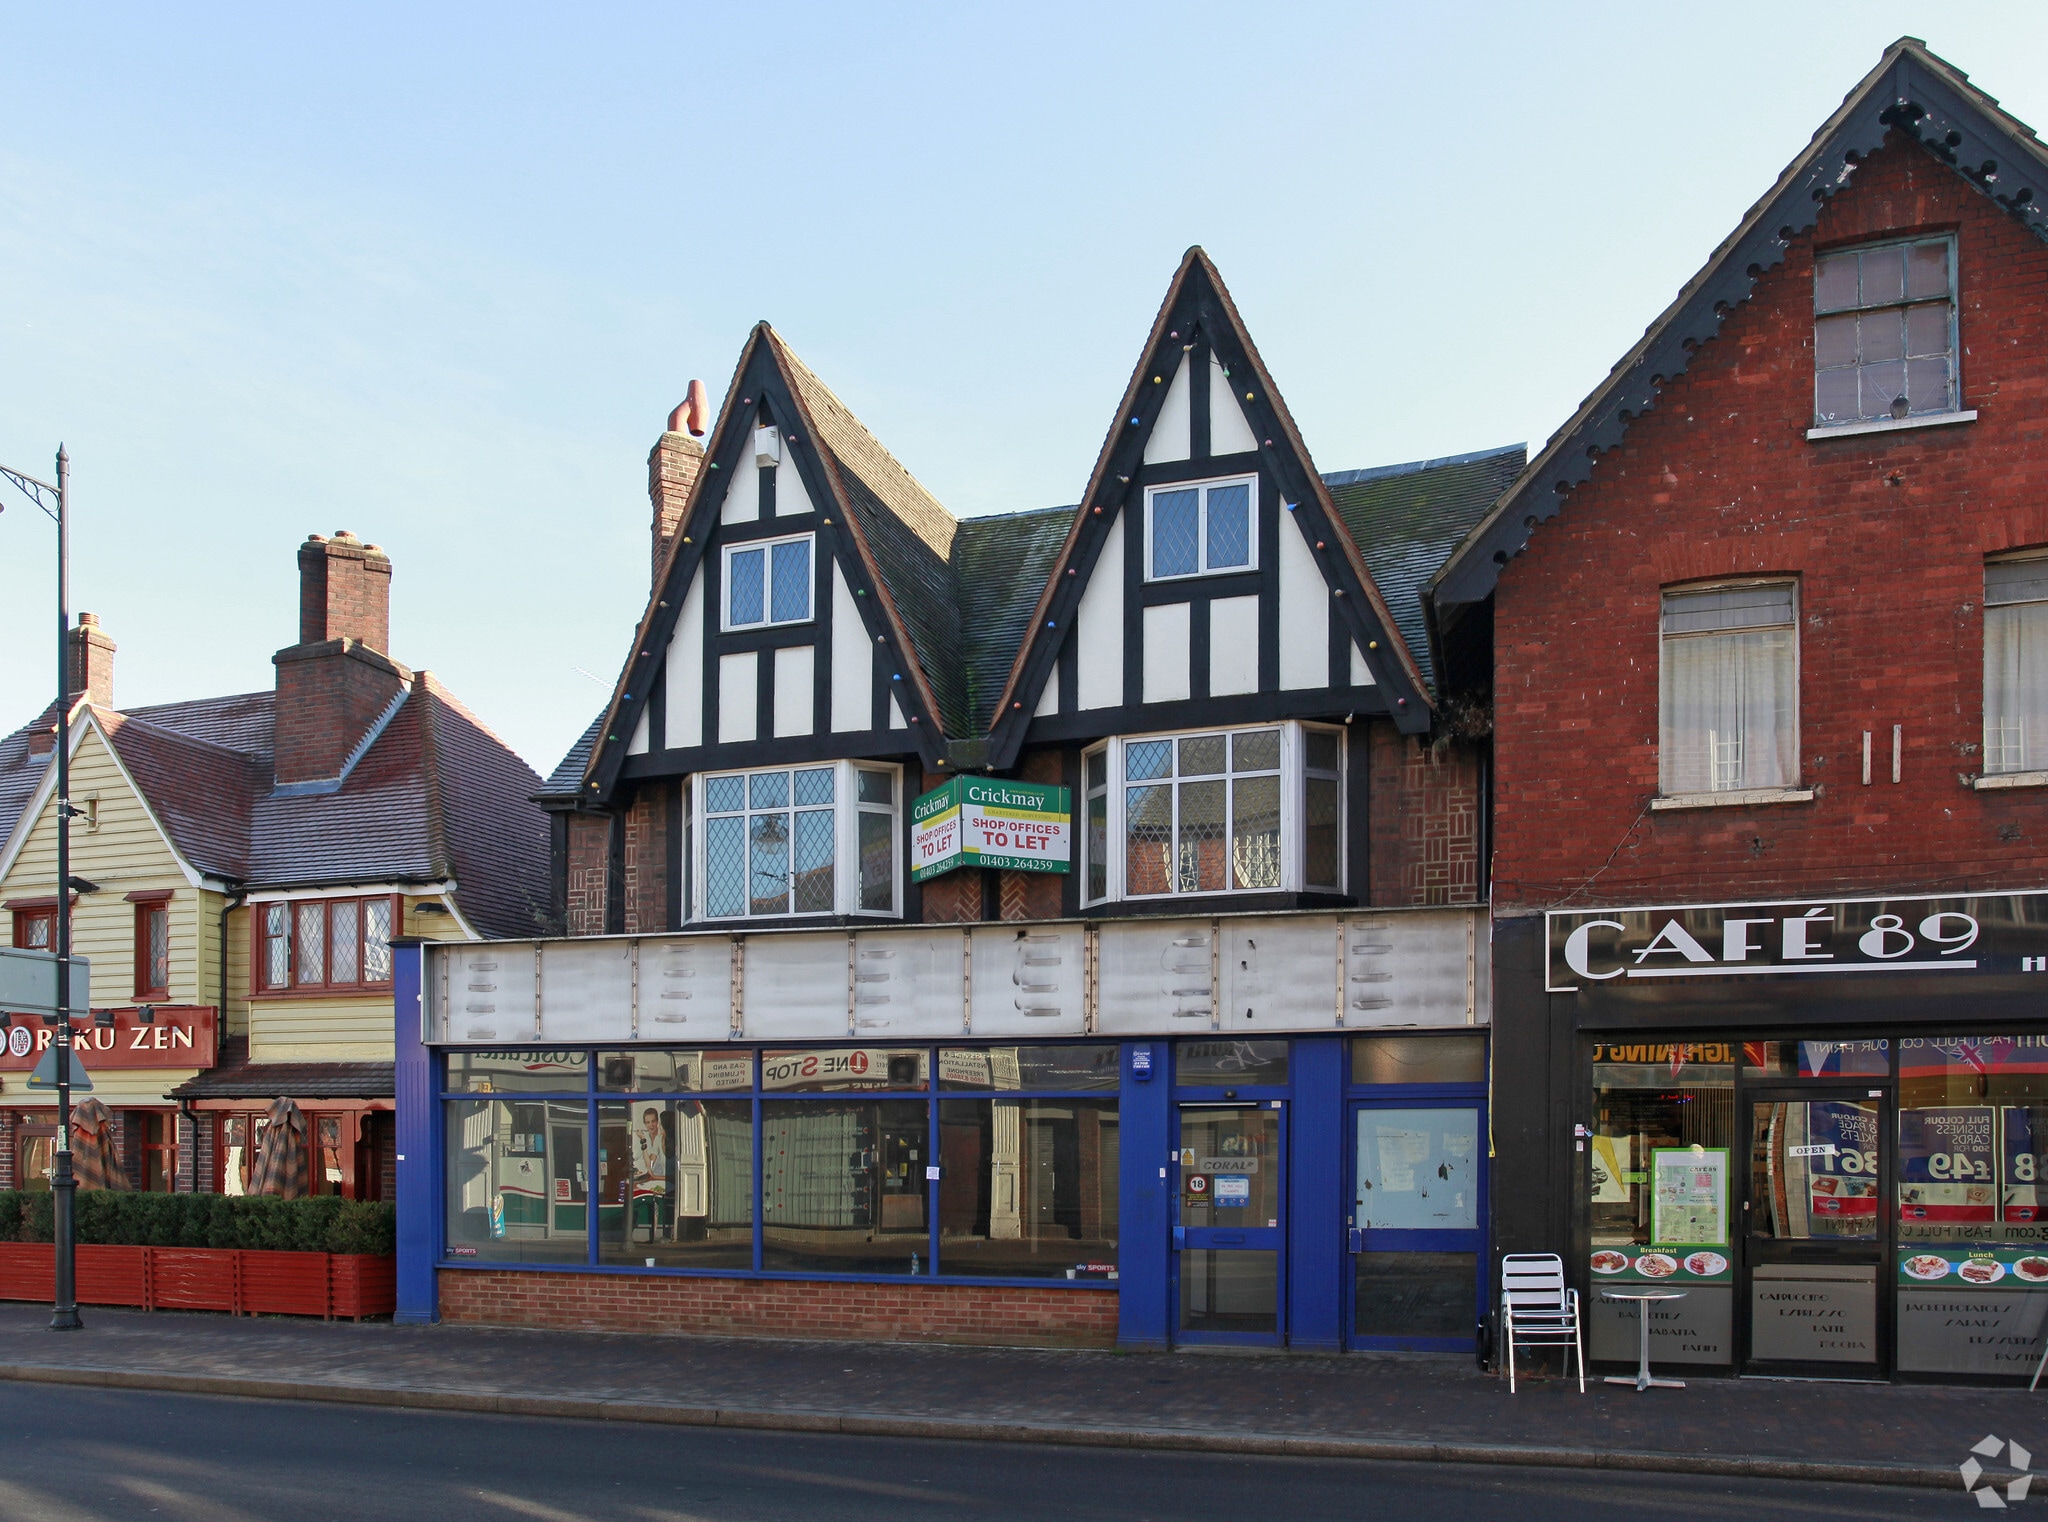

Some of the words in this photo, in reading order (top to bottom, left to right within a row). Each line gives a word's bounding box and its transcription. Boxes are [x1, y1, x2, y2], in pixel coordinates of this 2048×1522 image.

[914, 794, 949, 820] Crickmay
[968, 786, 1045, 811] Crickmay
[987, 809, 1020, 817] CHARTERED
[1021, 812, 1051, 820] SURVEYORS
[916, 819, 957, 845] SHOP/OFFICES
[972, 818, 1060, 835] SHOP/OFFICES
[921, 842, 934, 859] TO
[936, 833, 953, 853] LET
[983, 831, 1009, 847] TO
[1014, 834, 1050, 851] LET
[919, 865, 936, 879] 01403
[936, 858, 954, 875] 264259
[980, 855, 1010, 867] 01403
[1014, 858, 1053, 870] 264259
[1565, 907, 1834, 979] CAFÉ
[1859, 912, 1979, 958] 89
[37, 1028, 115, 1051] RKU
[130, 1026, 193, 1050] ZEN
[1796, 1146, 1826, 1155] OPEN
[1203, 1161, 1247, 1170] CORAL
[1191, 1179, 1204, 1188] 18
[1812, 1325, 1846, 1333] LATTE
[1945, 1319, 2001, 1328] SALADS
[1648, 1328, 1697, 1337] IABATTA
